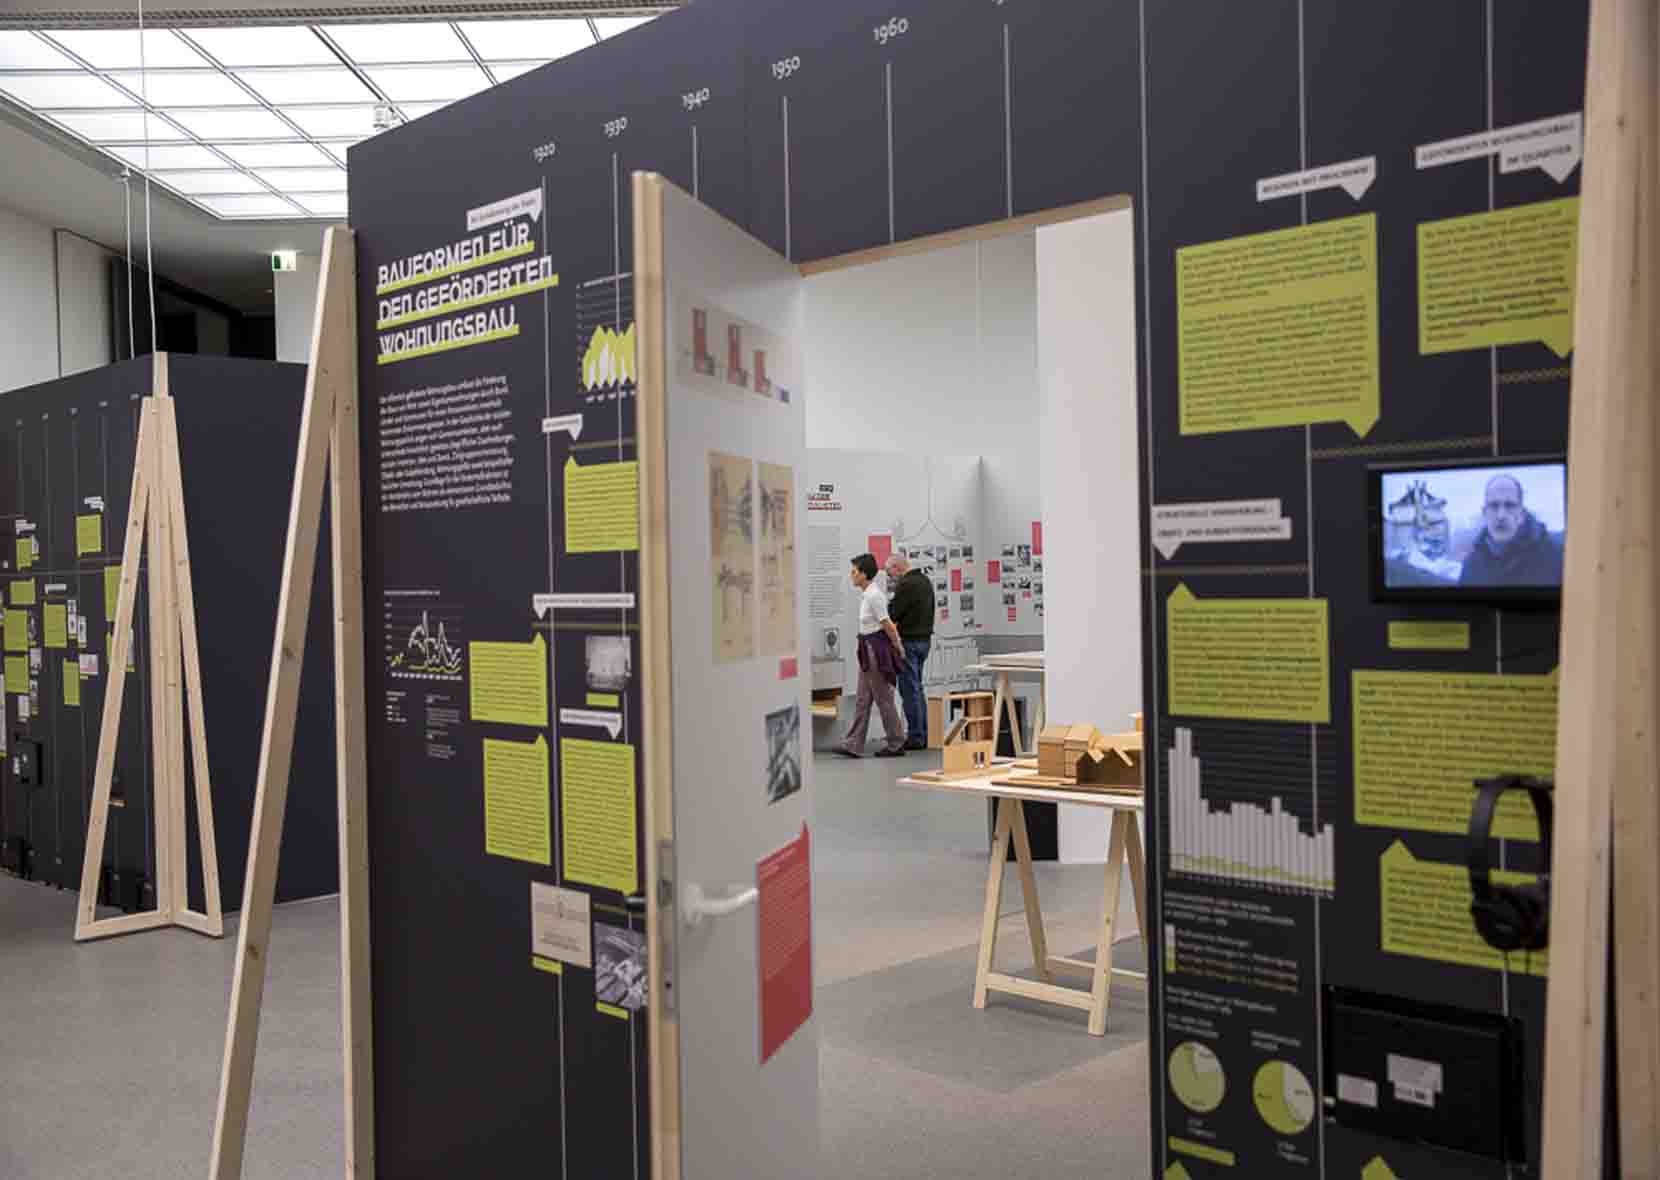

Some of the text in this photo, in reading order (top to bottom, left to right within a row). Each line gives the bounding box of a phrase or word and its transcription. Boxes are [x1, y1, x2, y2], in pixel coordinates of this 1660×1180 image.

[872, 16, 909, 45] 1960
[771, 55, 801, 80] 1950
[682, 87, 711, 111] 1940
[604, 116, 628, 139] 1930
[533, 140, 557, 164] 1920
[378, 220, 530, 289] BAUFORMEN FÜR
[379, 255, 552, 323] DEN GEFÖRDERTEN
[379, 304, 515, 355] WOHNUNGSBAU
